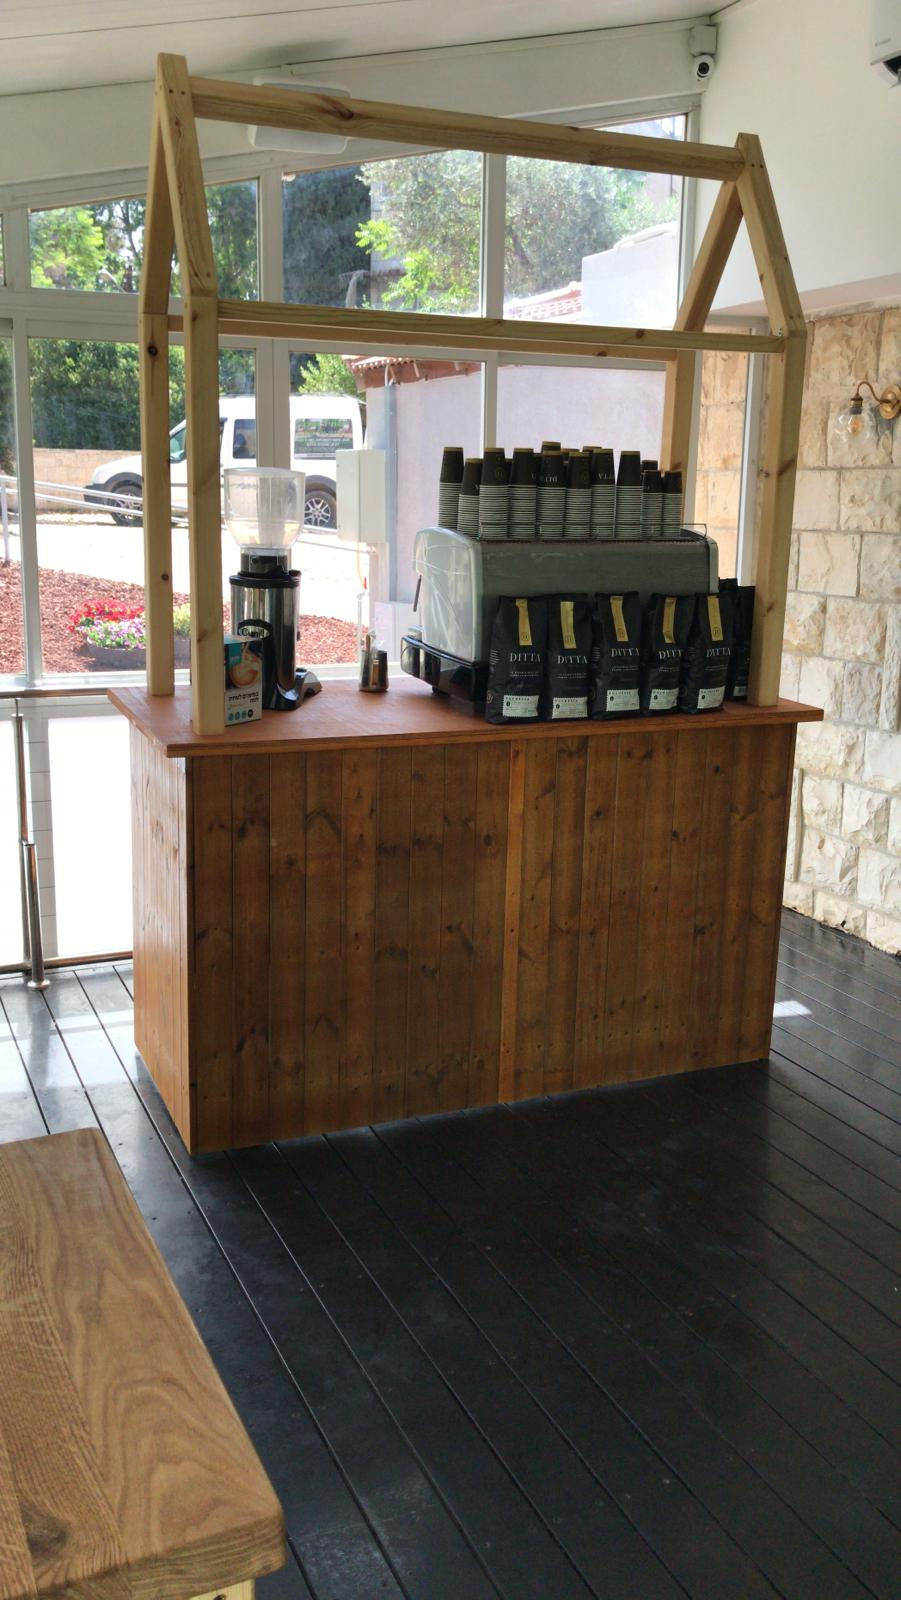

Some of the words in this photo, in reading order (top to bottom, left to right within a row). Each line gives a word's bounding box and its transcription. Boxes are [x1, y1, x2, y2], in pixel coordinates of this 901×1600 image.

[510, 652, 541, 663] DITTA
[611, 647, 640, 657] DITTA
[658, 649, 683, 660] DITT
[706, 647, 731, 658] DITTA
[557, 655, 588, 665] DITTA
